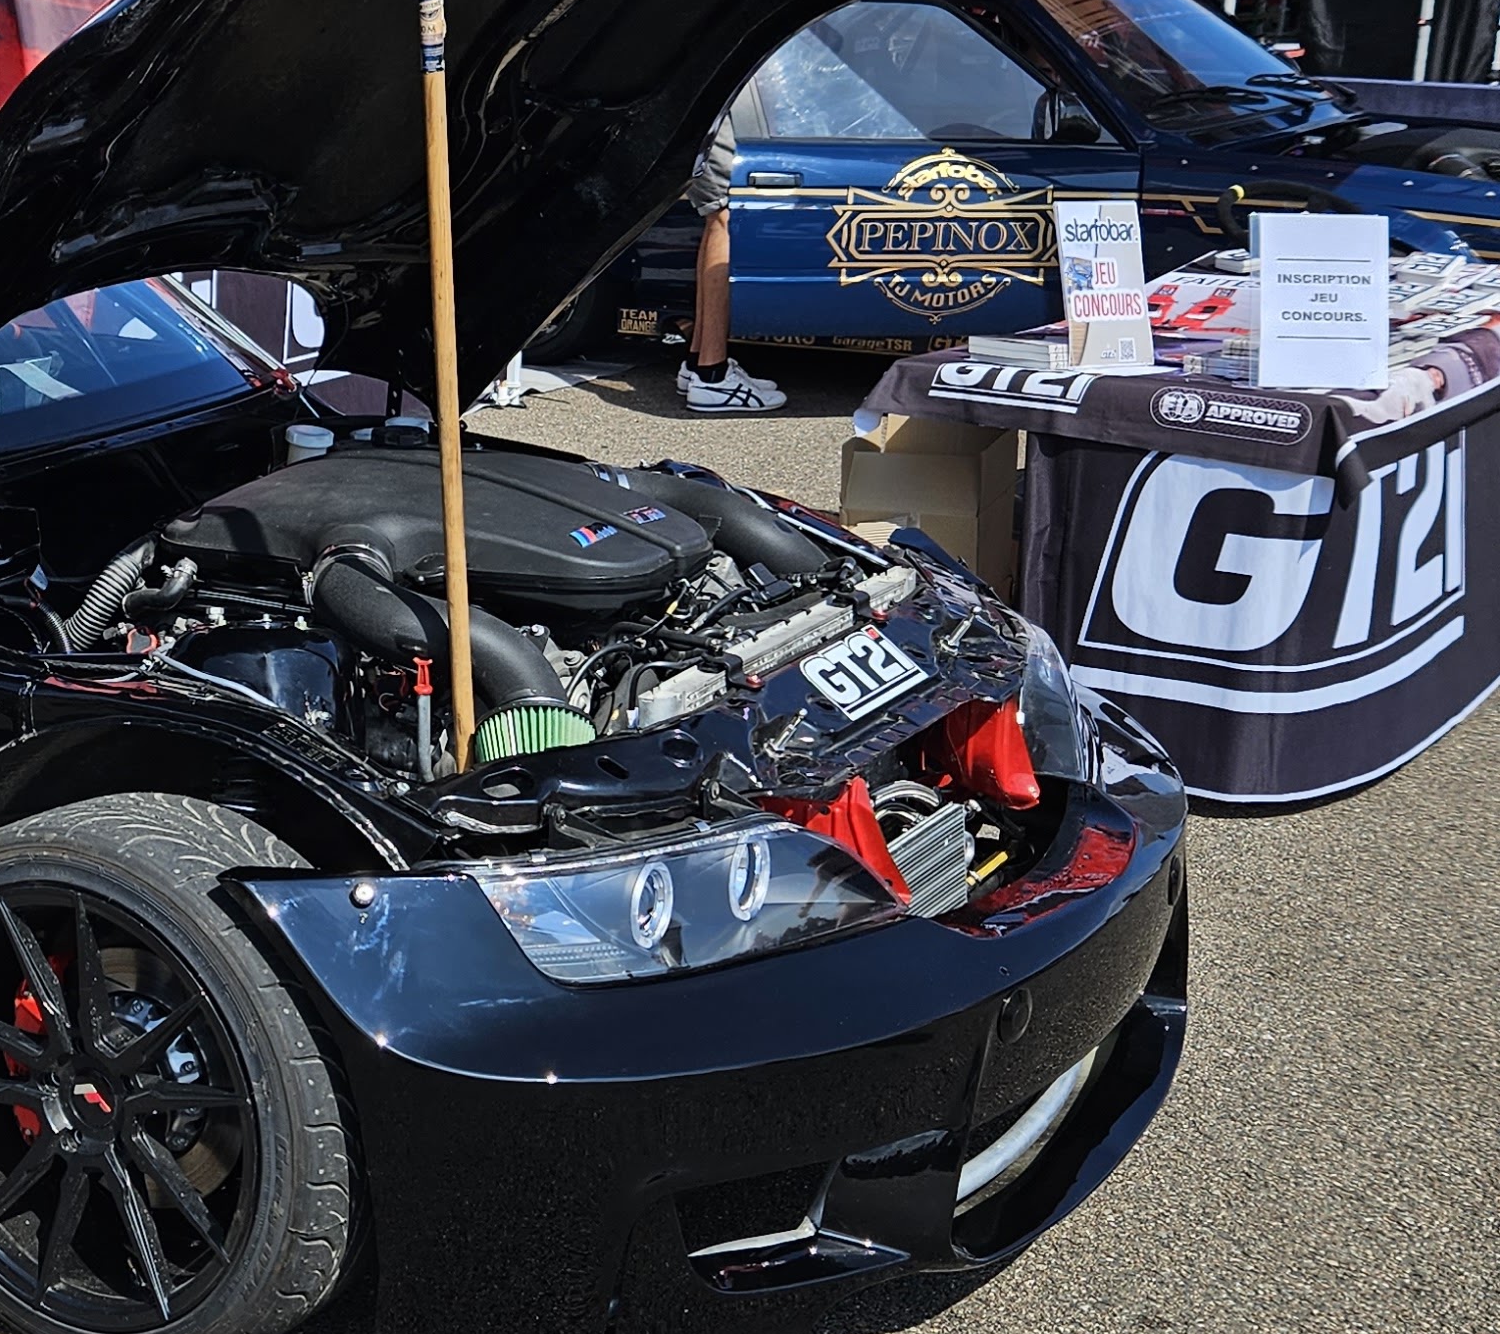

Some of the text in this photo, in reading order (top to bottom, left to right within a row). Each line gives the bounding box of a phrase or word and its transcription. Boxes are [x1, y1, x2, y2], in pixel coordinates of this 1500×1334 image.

[857, 220, 1036, 252] PEPINOX
[1094, 261, 1117, 285] JEU
[1276, 273, 1372, 286] INSCRIPTION
[910, 273, 998, 308] MOTORS
[1309, 292, 1339, 303] JEU
[1073, 293, 1143, 318] CONCOURS
[1281, 310, 1368, 323] CONCOURS.
[1160, 394, 1301, 430] FIA APPROVED
[802, 624, 920, 707] GT2i
